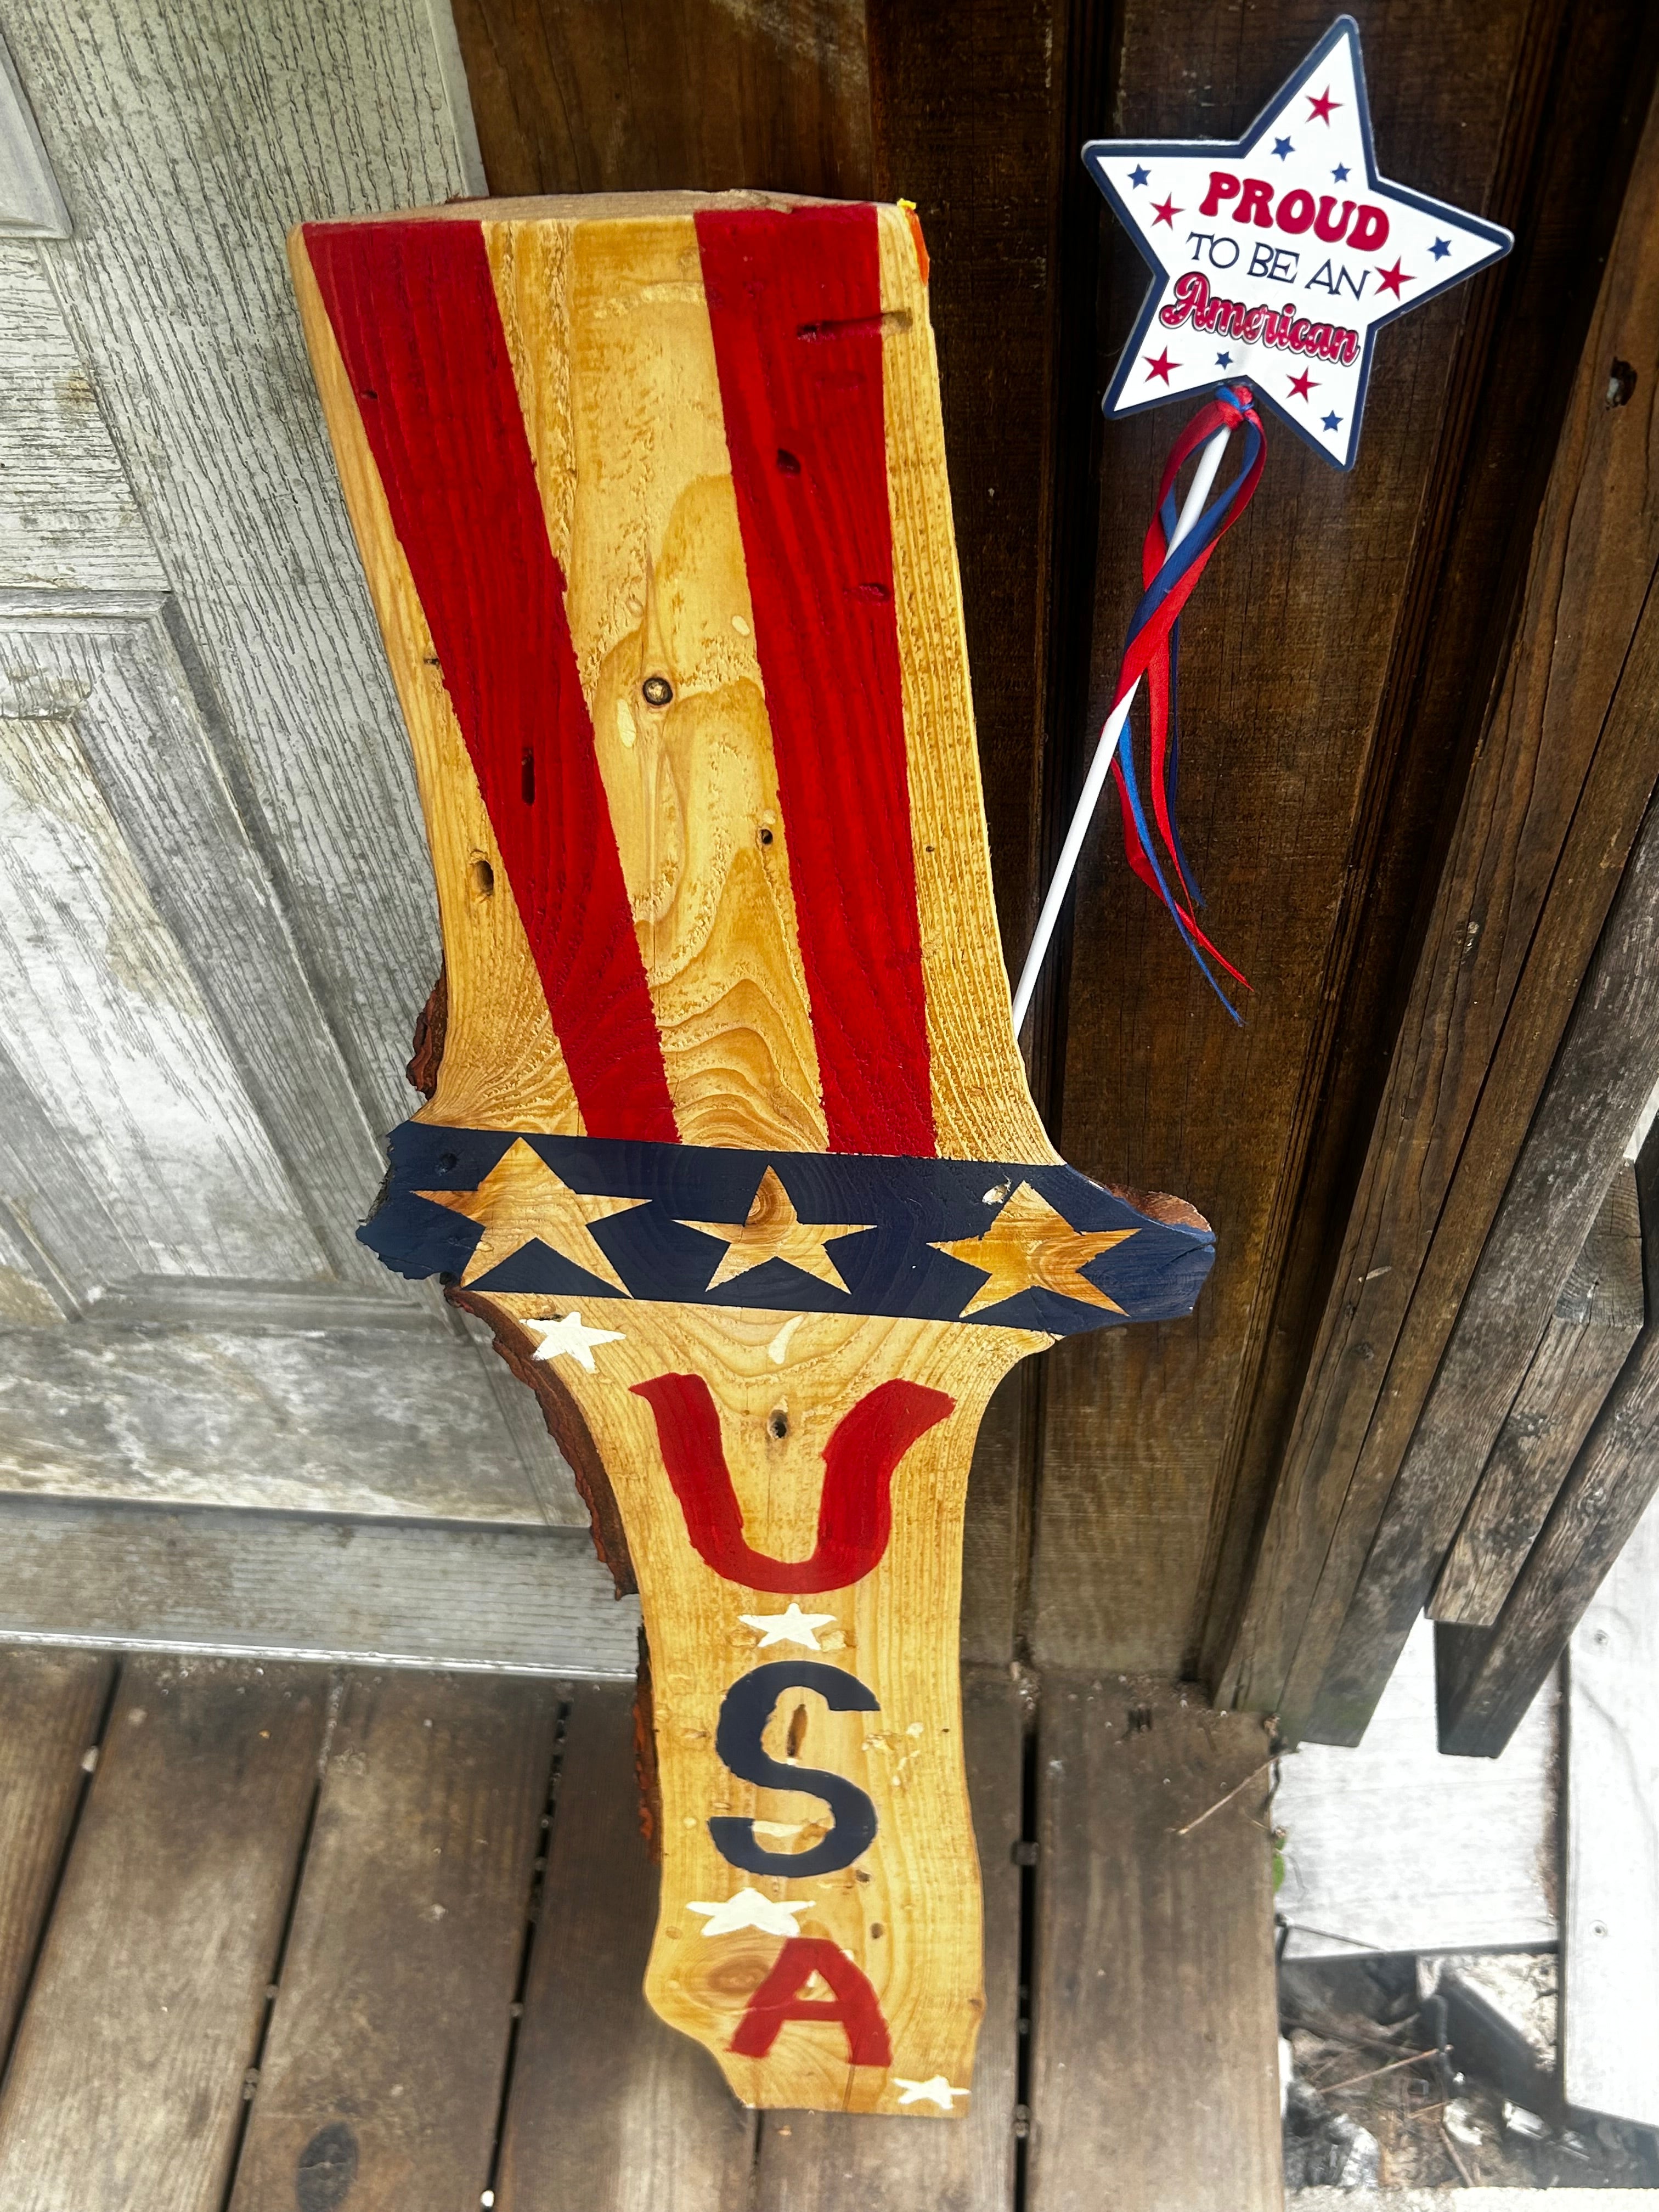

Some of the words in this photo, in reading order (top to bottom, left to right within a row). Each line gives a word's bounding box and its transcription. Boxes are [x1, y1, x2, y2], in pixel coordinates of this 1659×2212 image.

[1199, 171, 1390, 252] PROUD
[1186, 232, 1240, 269] TO
[1247, 241, 1300, 284] BE
[1305, 259, 1371, 301] AN
[1159, 272, 1361, 367] American
[629, 1373, 957, 2067] USA
